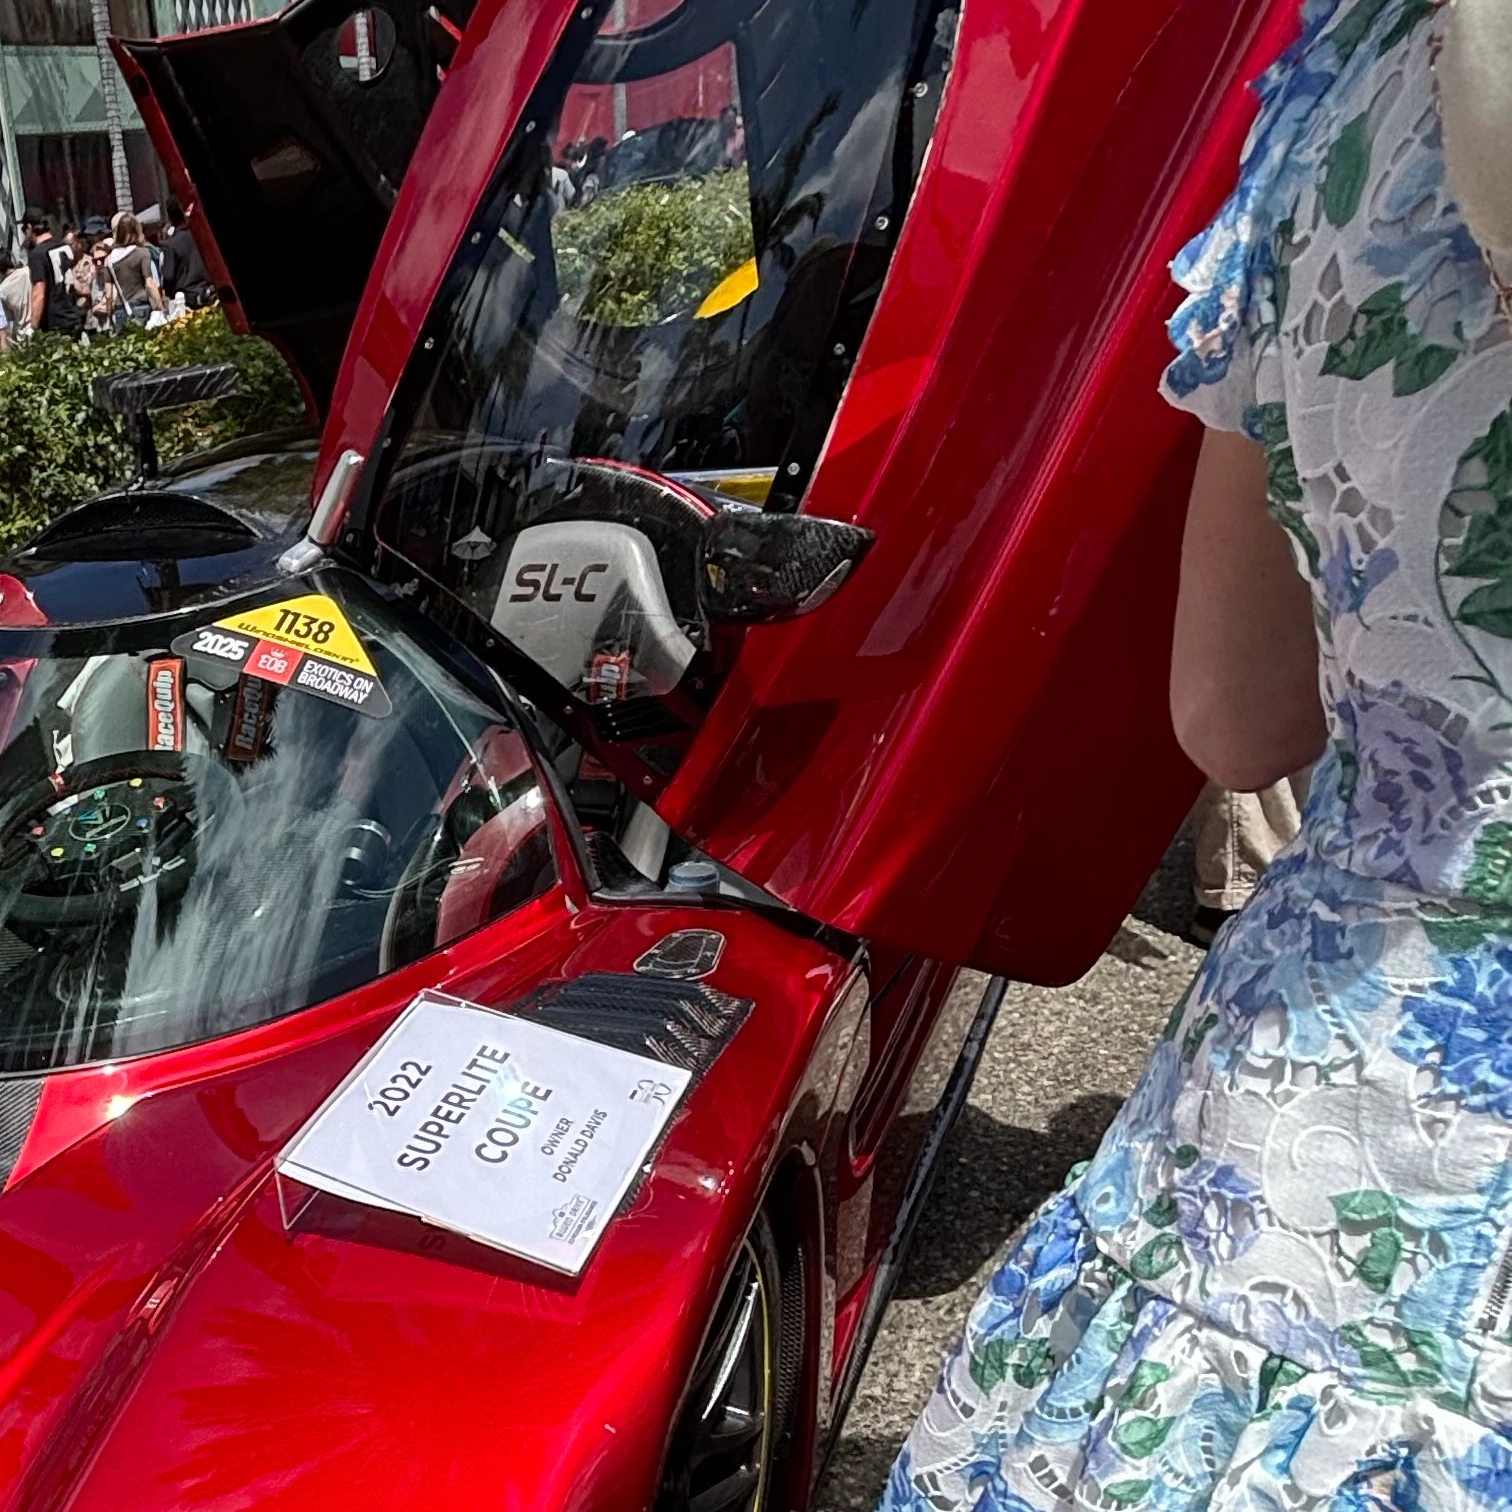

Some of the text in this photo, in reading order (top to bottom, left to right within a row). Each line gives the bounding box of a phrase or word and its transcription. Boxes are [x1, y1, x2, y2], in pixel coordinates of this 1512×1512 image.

[509, 563, 609, 603] SL-C
[273, 608, 335, 644] 1138
[192, 631, 250, 661] 2025
[296, 672, 369, 705] BROADWAY
[303, 659, 374, 694] EXOTICS ON
[367, 1061, 433, 1117] 2022
[397, 1045, 511, 1171] SUPERLITE
[474, 1081, 553, 1164] COUPE
[540, 1117, 575, 1156] OWNER
[552, 1138, 588, 1184] DONALD
[580, 1108, 608, 1140] DAVIS
